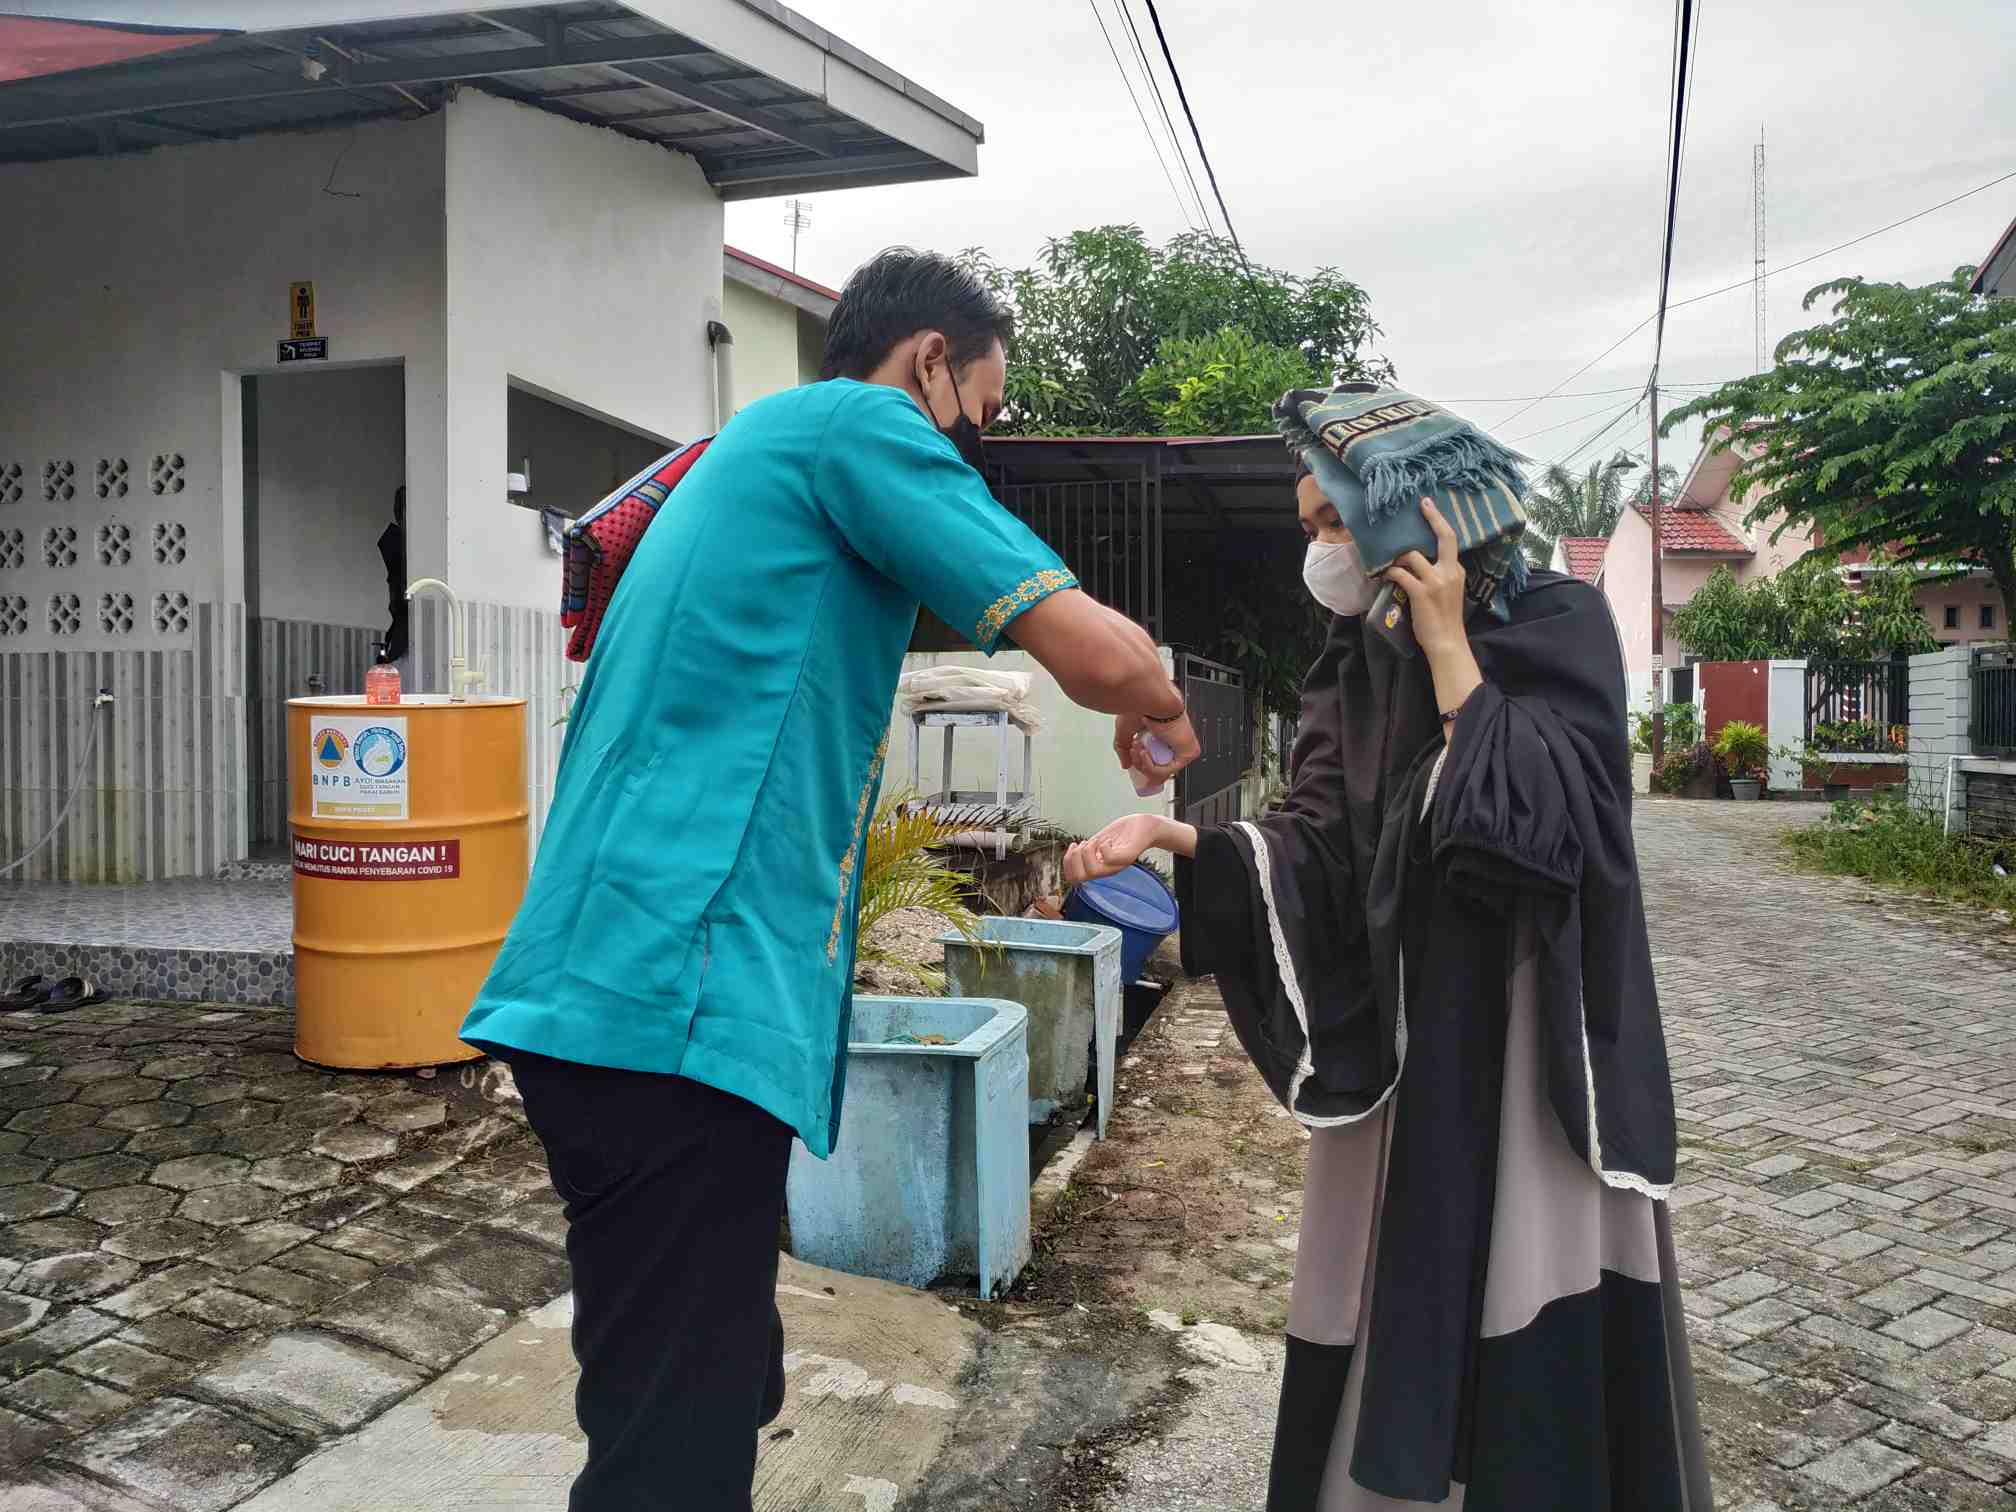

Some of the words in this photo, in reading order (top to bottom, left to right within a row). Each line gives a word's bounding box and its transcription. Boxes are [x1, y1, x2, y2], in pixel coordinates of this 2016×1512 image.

[312, 774, 351, 787] BNPB
[294, 840, 317, 860] MARI
[320, 845, 355, 862] CUCI
[359, 846, 436, 863] TANGAN
[332, 865, 358, 876] RANTAI
[360, 866, 416, 876] PENYEBARAN
[417, 865, 442, 875] COVID
